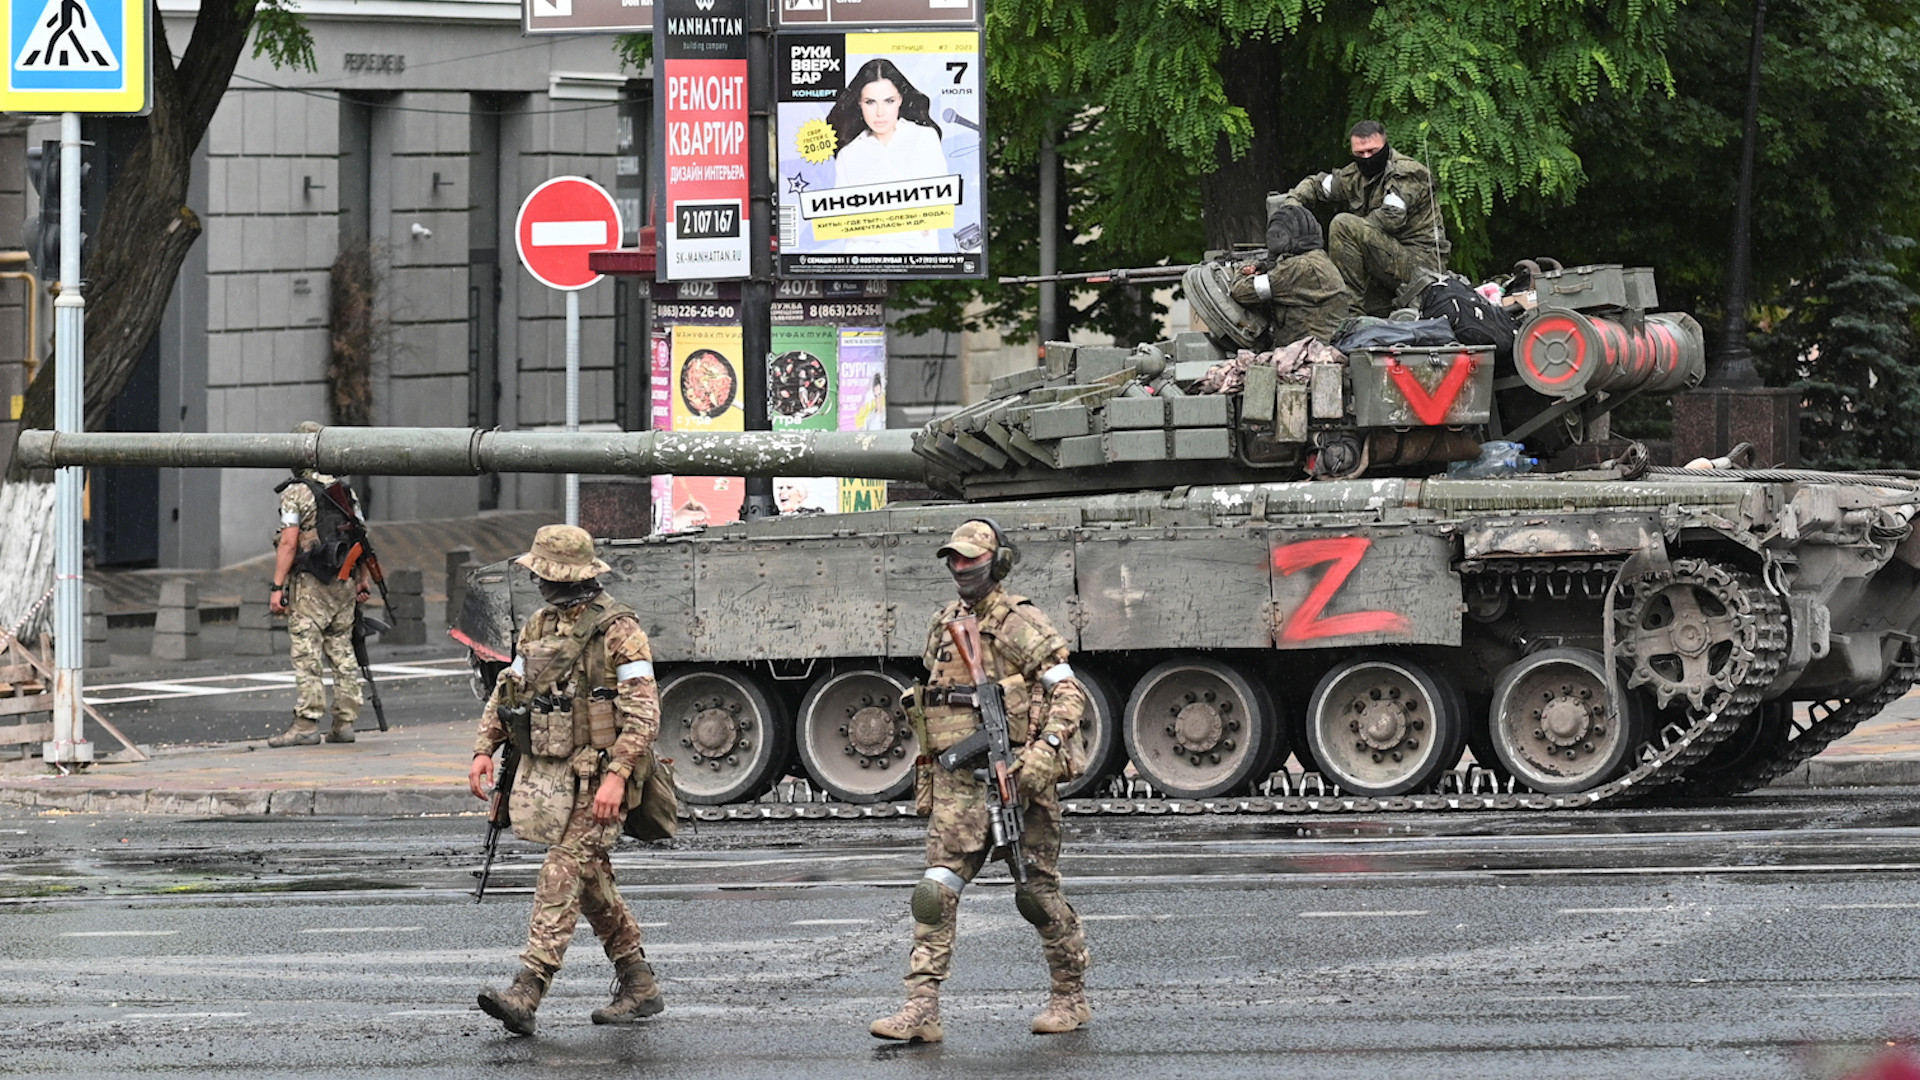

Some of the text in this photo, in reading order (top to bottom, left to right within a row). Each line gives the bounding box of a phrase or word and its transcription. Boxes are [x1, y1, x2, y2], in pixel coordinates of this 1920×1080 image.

[668, 17, 743, 36] MANHATTAN
[683, 41, 728, 51] building company
[791, 46, 831, 59] РУКИ
[791, 59, 840, 71] ВВЕРХ
[946, 62, 968, 84] 7
[791, 72, 822, 85] БАР
[668, 76, 744, 111] РЕМОНТ
[792, 90, 837, 98] КОНЦЕРТ
[668, 121, 745, 156] КВАРТИР
[804, 139, 831, 154] 20:00
[670, 162, 745, 184] ДИЗАЙН ИНТЕРЬЕРА
[811, 184, 952, 213] ИНФИНИТИ
[683, 209, 733, 234] 2 107 167
[676, 250, 742, 264] SK-MANHATTAN.RU
[680, 281, 714, 297] 40/2
[780, 280, 819, 296] 40/1
[770, 302, 804, 310] ЛУЖБА
[1386, 350, 1480, 426] V
[1272, 536, 1410, 642] Z
